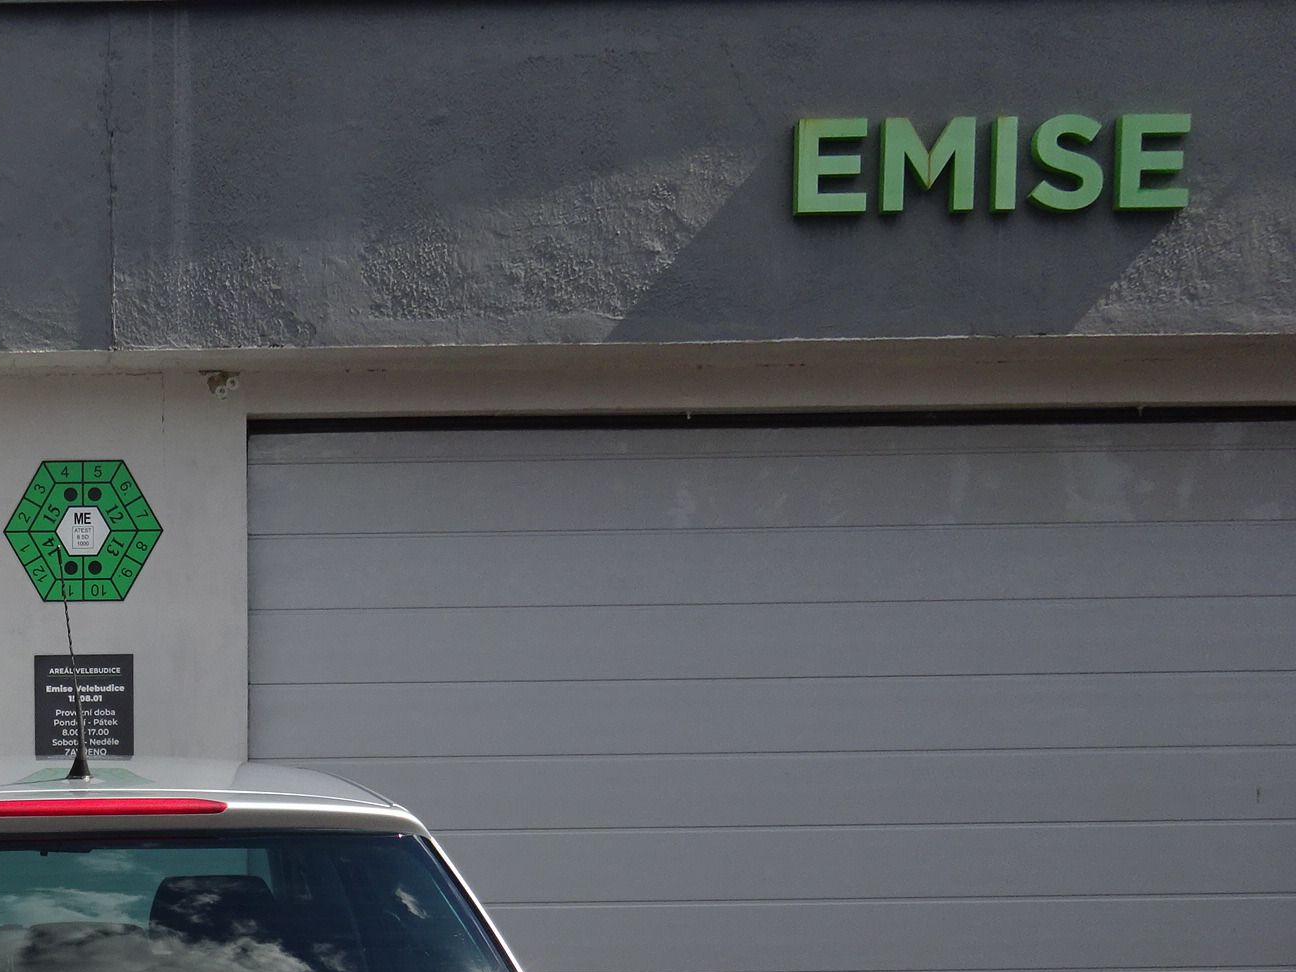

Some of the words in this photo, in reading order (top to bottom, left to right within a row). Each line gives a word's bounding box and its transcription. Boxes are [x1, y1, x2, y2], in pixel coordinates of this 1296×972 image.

[793, 114, 1191, 216] EMISE
[61, 466, 69, 477] 4
[94, 466, 102, 477] 5
[34, 483, 46, 494] 3
[18, 512, 32, 523] 2
[43, 503, 61, 524] 15
[74, 512, 91, 525] ME
[105, 504, 124, 524] 12
[135, 510, 148, 519] 7
[20, 543, 31, 553] 1
[106, 537, 124, 557] 13
[135, 541, 148, 551] 8
[32, 565, 48, 582] 12
[91, 584, 106, 596] 10
[49, 666, 73, 674] AREÁL
[46, 685, 73, 693] Emise
[76, 684, 125, 692] Velebudice
[94, 708, 116, 716] doba
[94, 718, 118, 726] Pátek
[88, 728, 109, 736] 17.00
